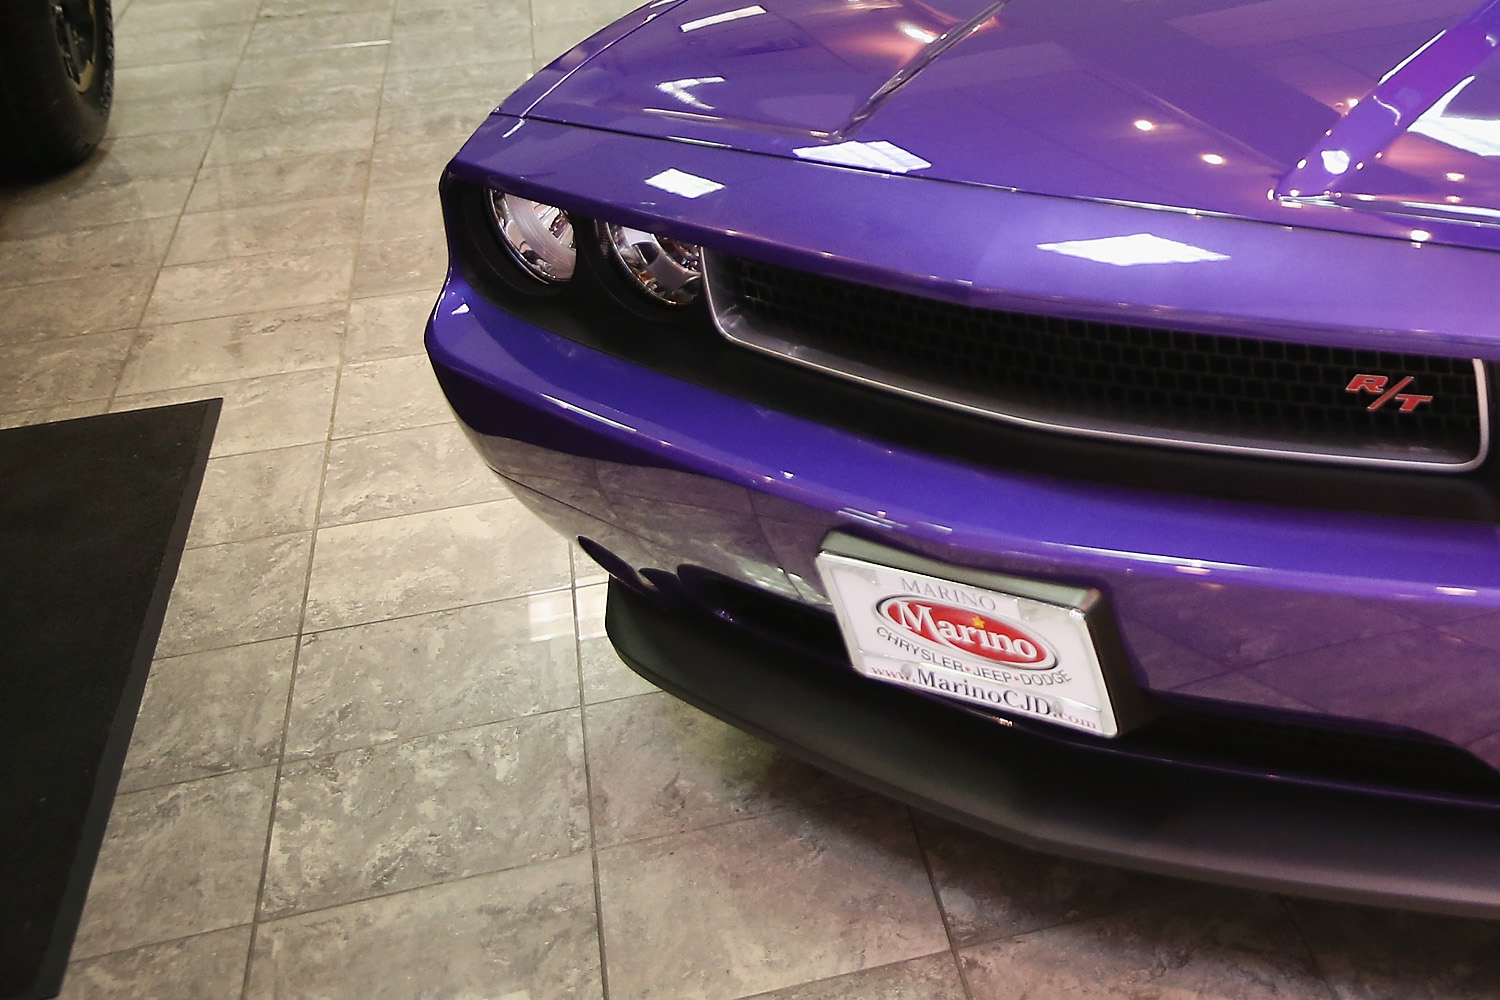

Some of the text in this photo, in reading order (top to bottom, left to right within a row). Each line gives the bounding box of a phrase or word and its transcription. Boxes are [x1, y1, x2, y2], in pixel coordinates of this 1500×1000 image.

[1344, 373, 1434, 414] R/T
[900, 577, 996, 611] MARINO
[876, 626, 1073, 686] CHRYSLER JEEP DODGE
[898, 600, 1038, 660] Marino
[871, 665, 1098, 730] www.MarinoCJD.com
